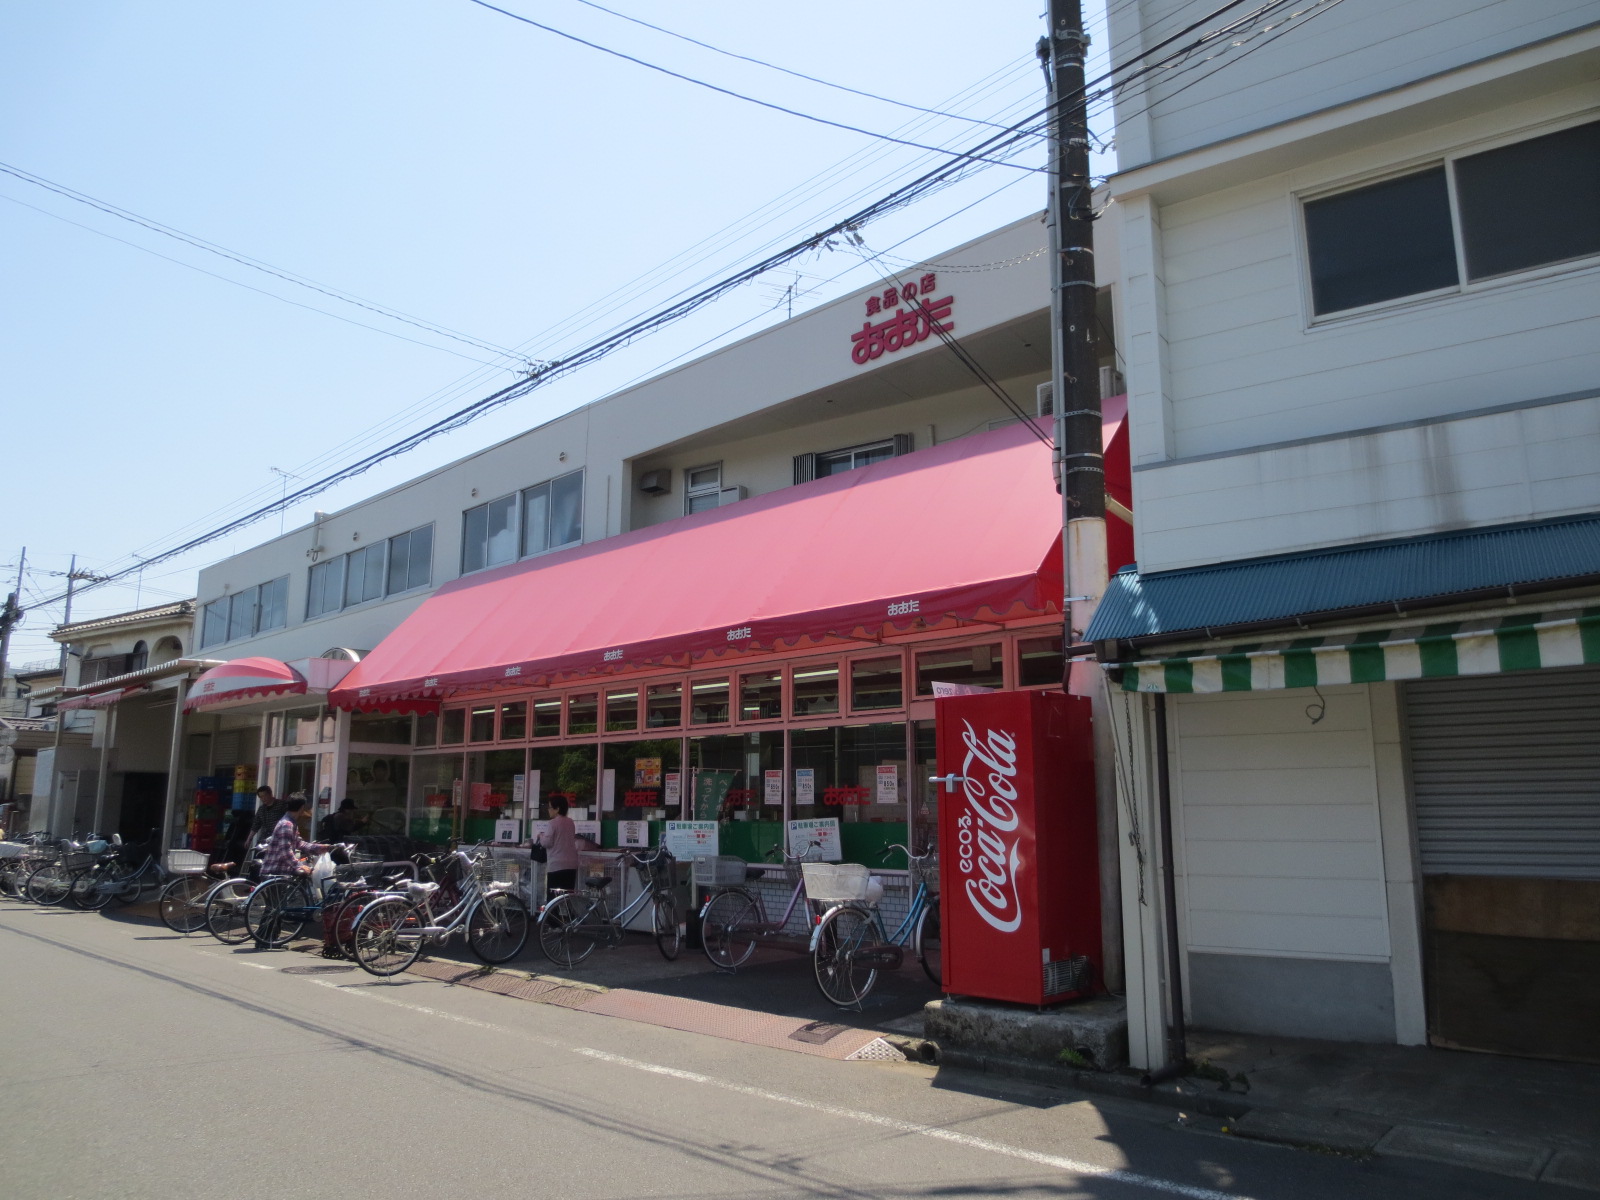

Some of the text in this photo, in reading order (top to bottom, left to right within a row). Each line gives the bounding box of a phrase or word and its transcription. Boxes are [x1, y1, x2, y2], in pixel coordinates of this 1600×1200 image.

[865, 273, 936, 316] 食品の店
[851, 296, 954, 364] おおた
[887, 600, 920, 616] おおた
[726, 627, 752, 641] おおた
[603, 649, 624, 661] おおた
[823, 784, 871, 806] おおた
[961, 718, 1022, 933] Coca-Cola
